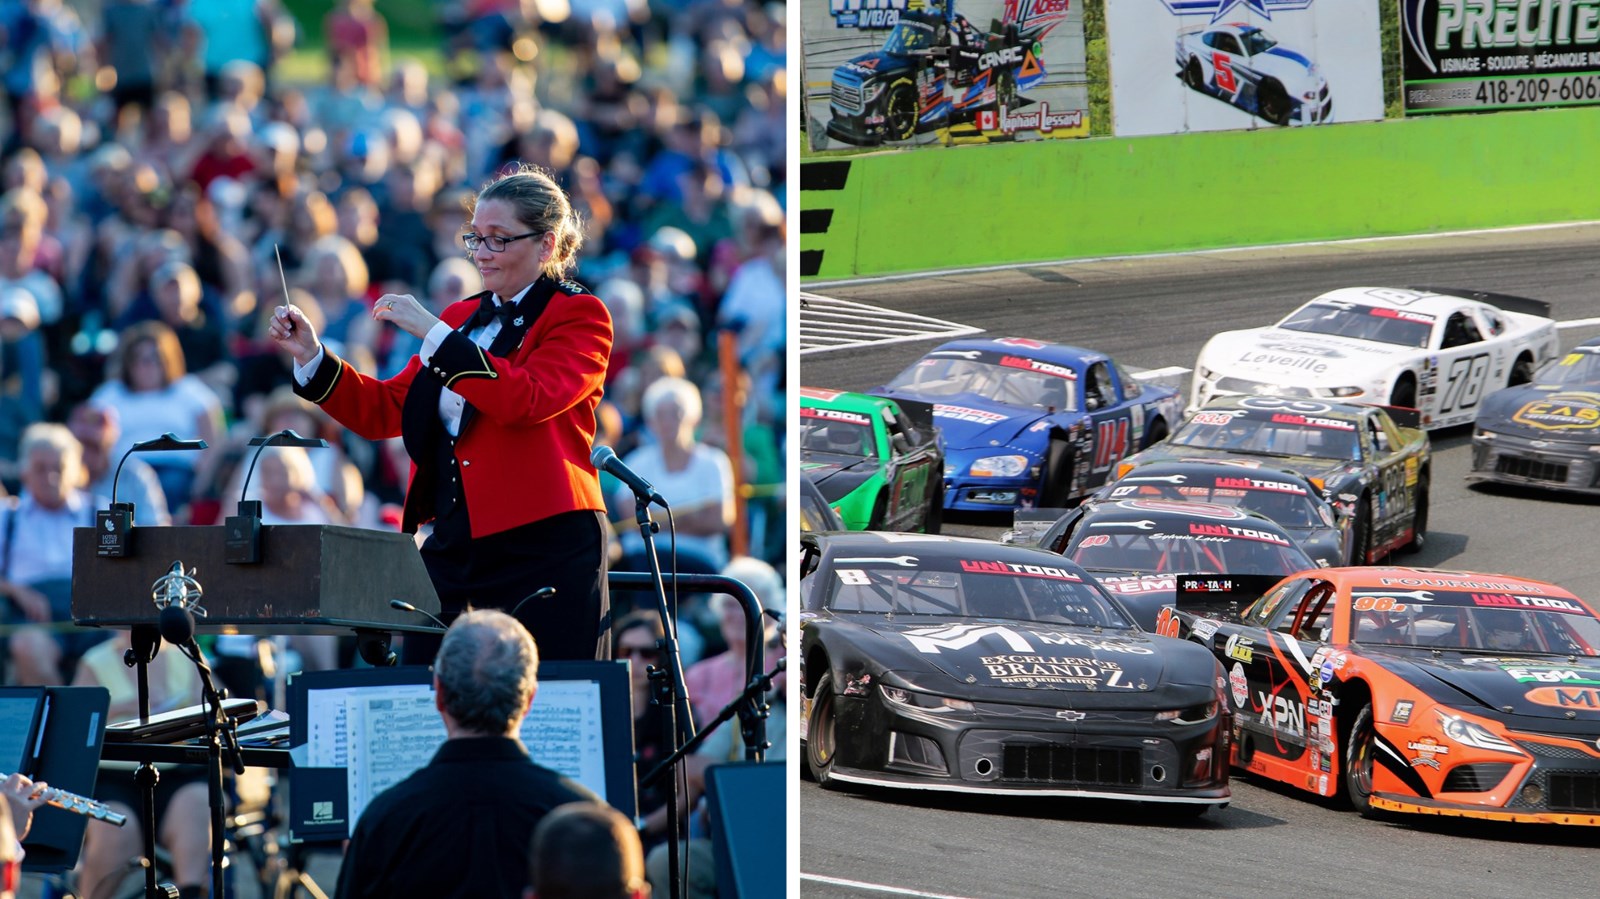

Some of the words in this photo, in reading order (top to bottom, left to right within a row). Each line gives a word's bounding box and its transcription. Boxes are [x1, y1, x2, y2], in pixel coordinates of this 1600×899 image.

[978, 46, 1023, 70] CANAC
[1440, 57, 1481, 72] USINAGE
[1487, 54, 1529, 70] SOUDURE
[1212, 52, 1237, 93] 5
[1475, 76, 1600, 104] 418-209-606
[1041, 102, 1080, 130] Lessard
[1440, 353, 1490, 414] 78
[1184, 580, 1232, 591] PRO-TACH
[1380, 577, 1546, 594] FOURNIER
[979, 655, 1122, 670] EXCELLENCE
